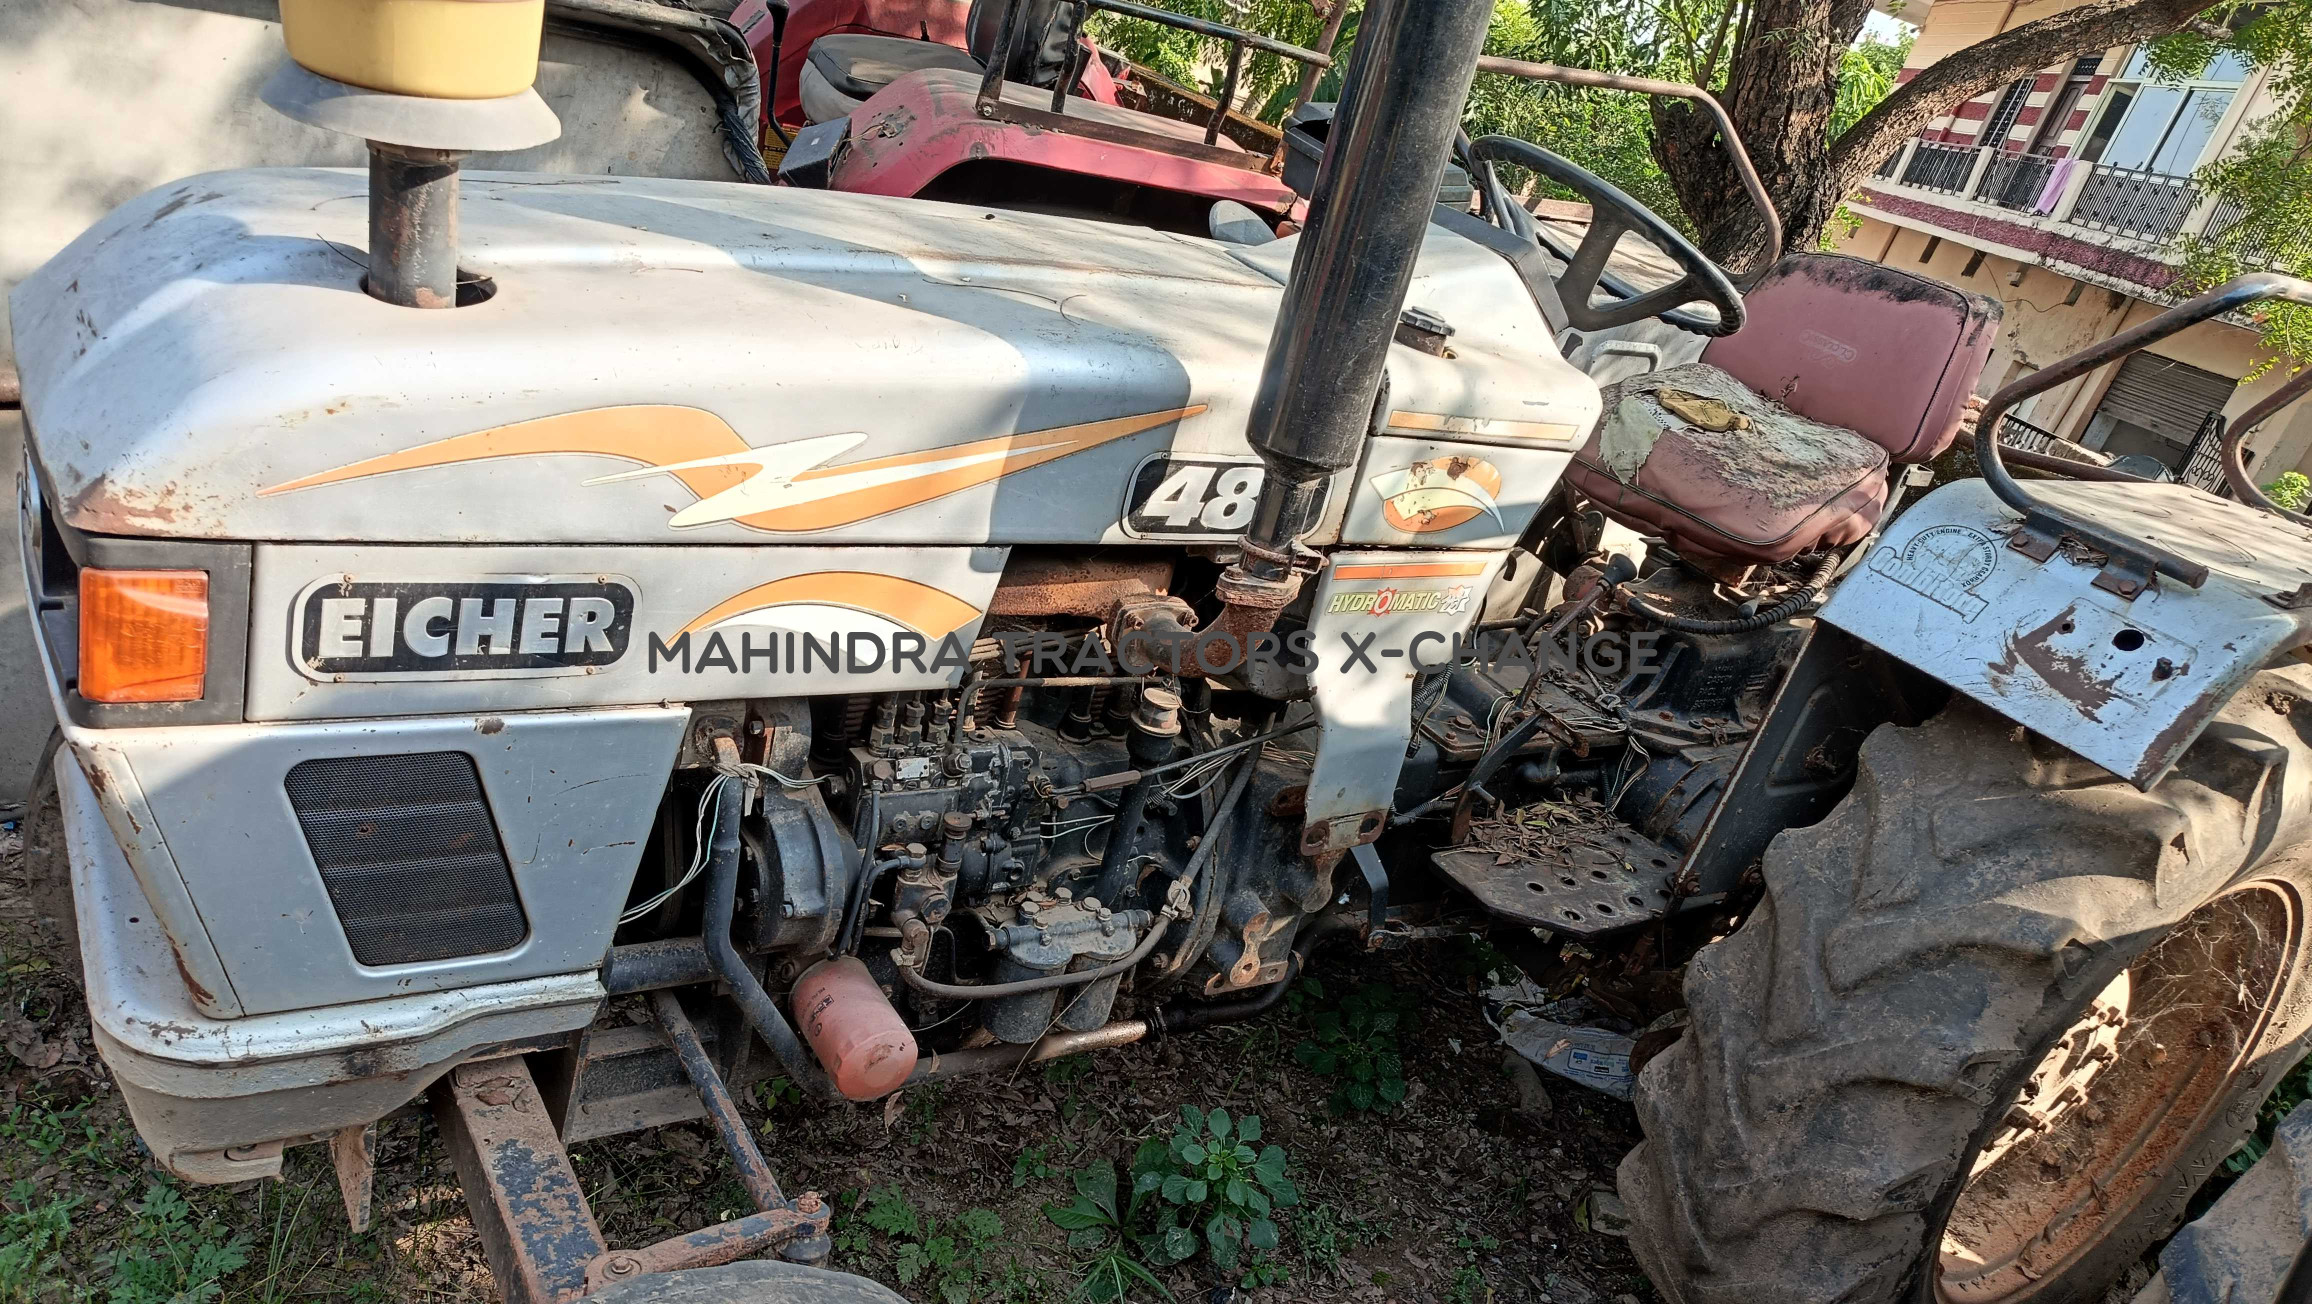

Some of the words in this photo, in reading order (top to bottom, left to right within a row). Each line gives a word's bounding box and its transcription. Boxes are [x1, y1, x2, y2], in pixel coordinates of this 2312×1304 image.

[1141, 466, 1265, 529] 48
[1967, 532, 1987, 546] EXTRA
[1961, 566, 1989, 588] GEARBOX
[1328, 590, 1442, 615] HYDROMATIC
[319, 596, 616, 658] EICHER
